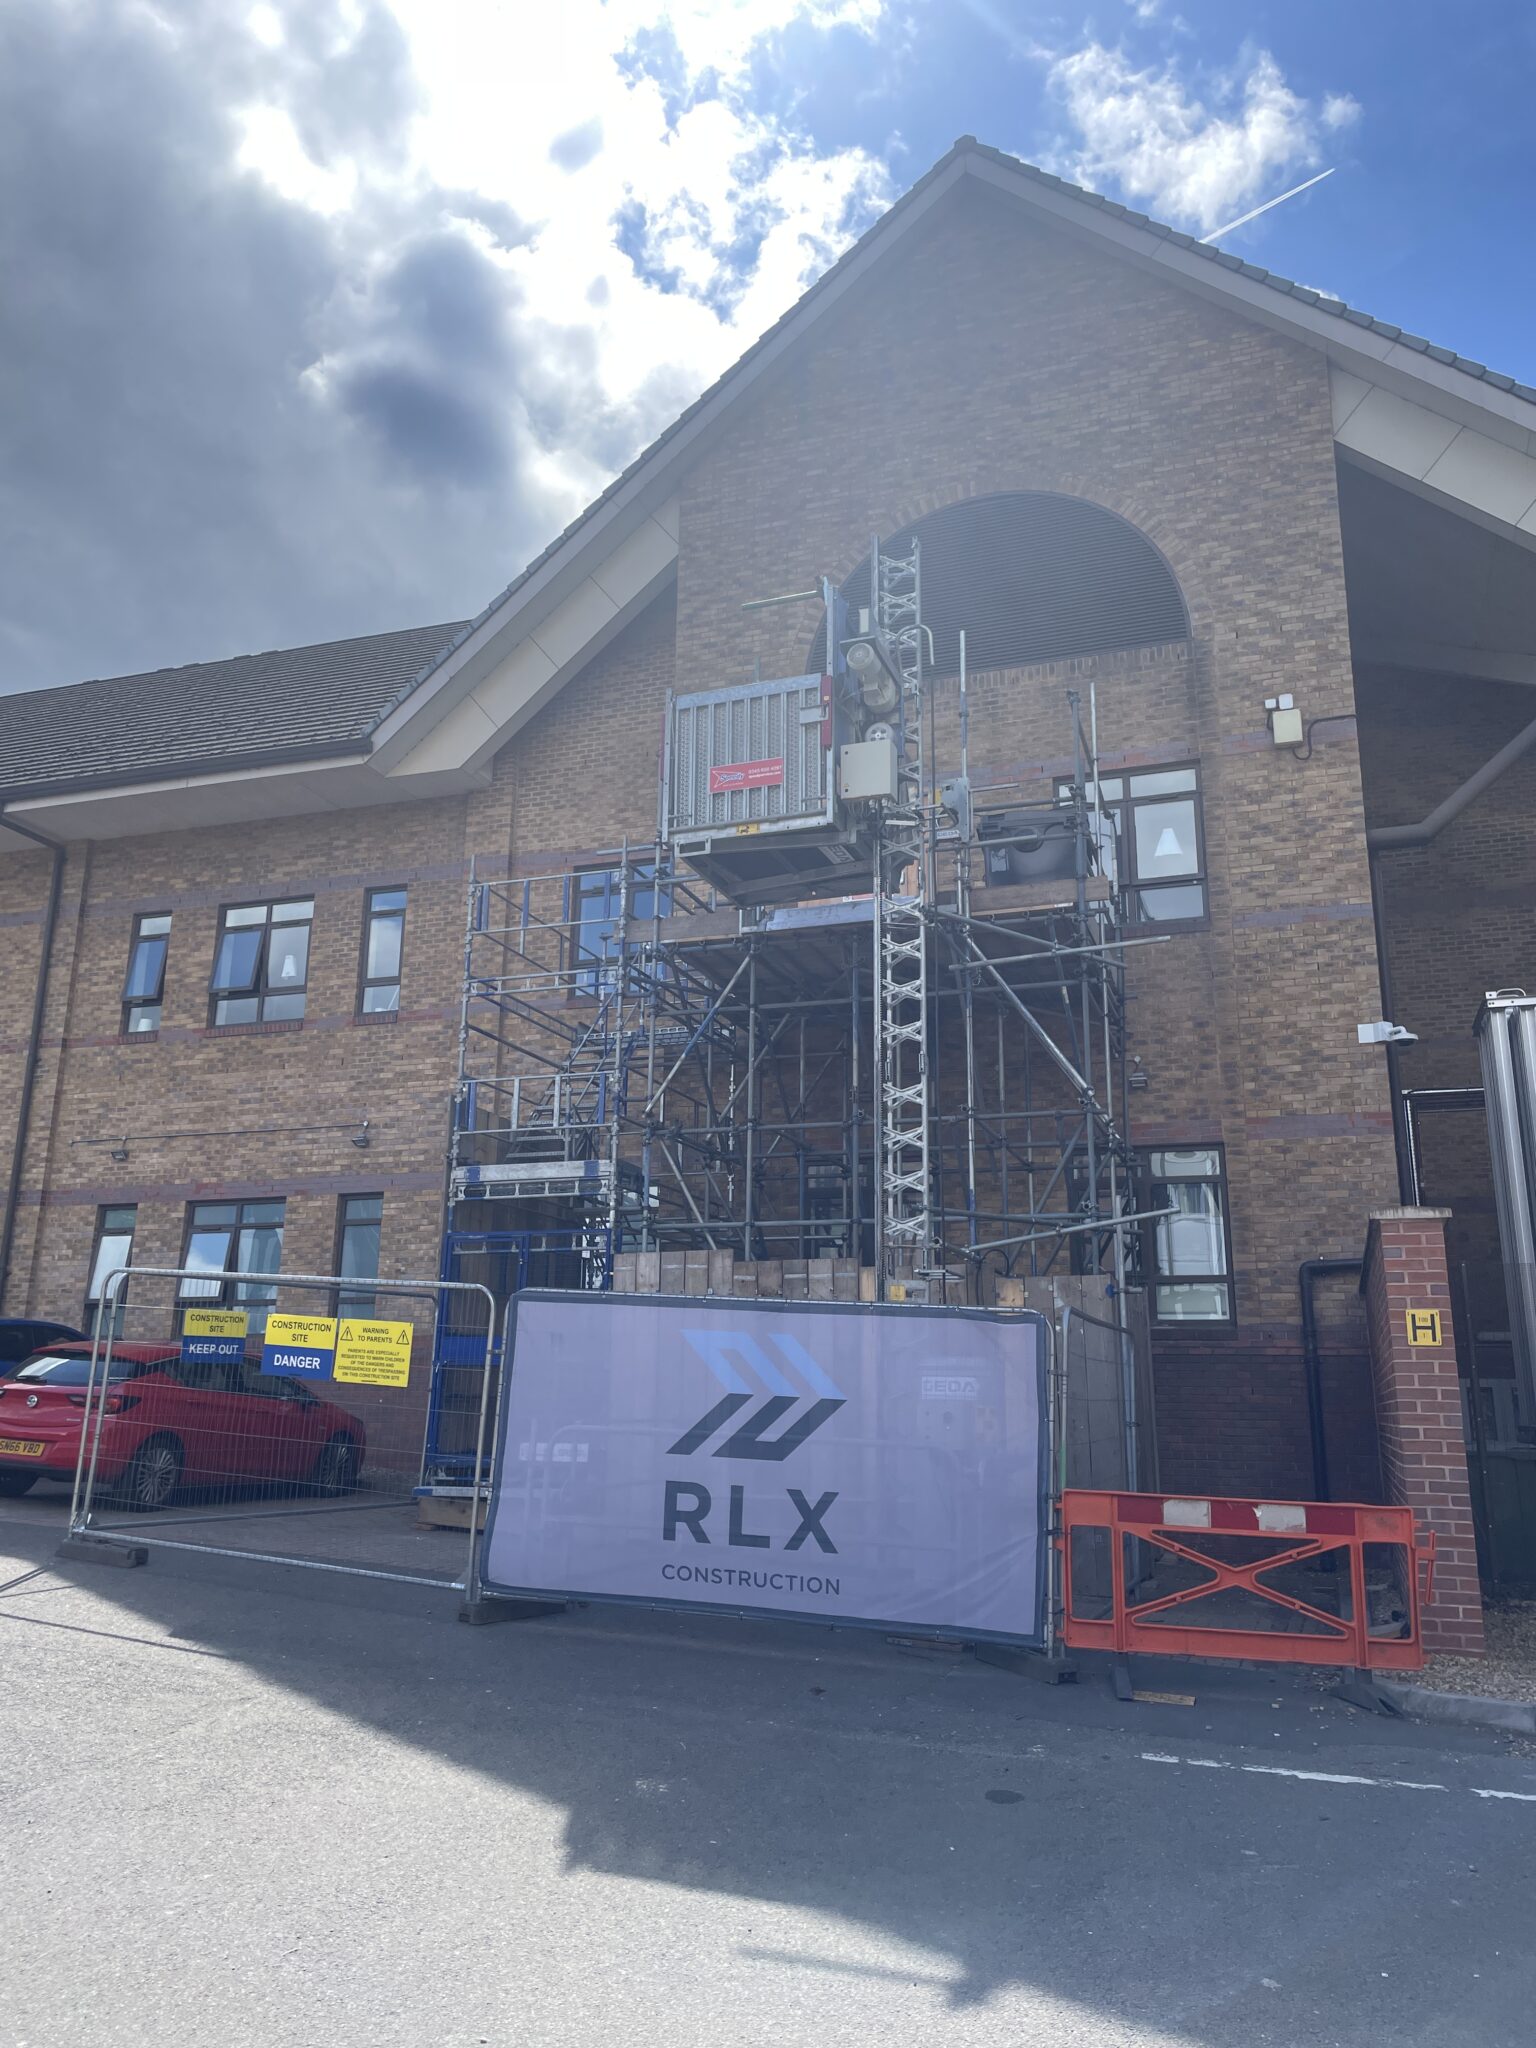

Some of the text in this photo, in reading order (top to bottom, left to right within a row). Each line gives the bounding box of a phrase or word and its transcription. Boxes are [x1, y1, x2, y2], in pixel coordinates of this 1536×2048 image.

[190, 1314, 245, 1324] CONSTRUCTION
[209, 1325, 225, 1333] SITE
[271, 1320, 332, 1332] CONSTRUCTION
[362, 1327, 389, 1335] WARNING
[1411, 1314, 1437, 1342] H
[291, 1333, 308, 1342] SITE
[188, 1343, 239, 1355] KEEP OUT
[273, 1354, 321, 1370] DANGER
[663, 1480, 839, 1554] RLX
[661, 1563, 840, 1595] CONSTRUCTION
